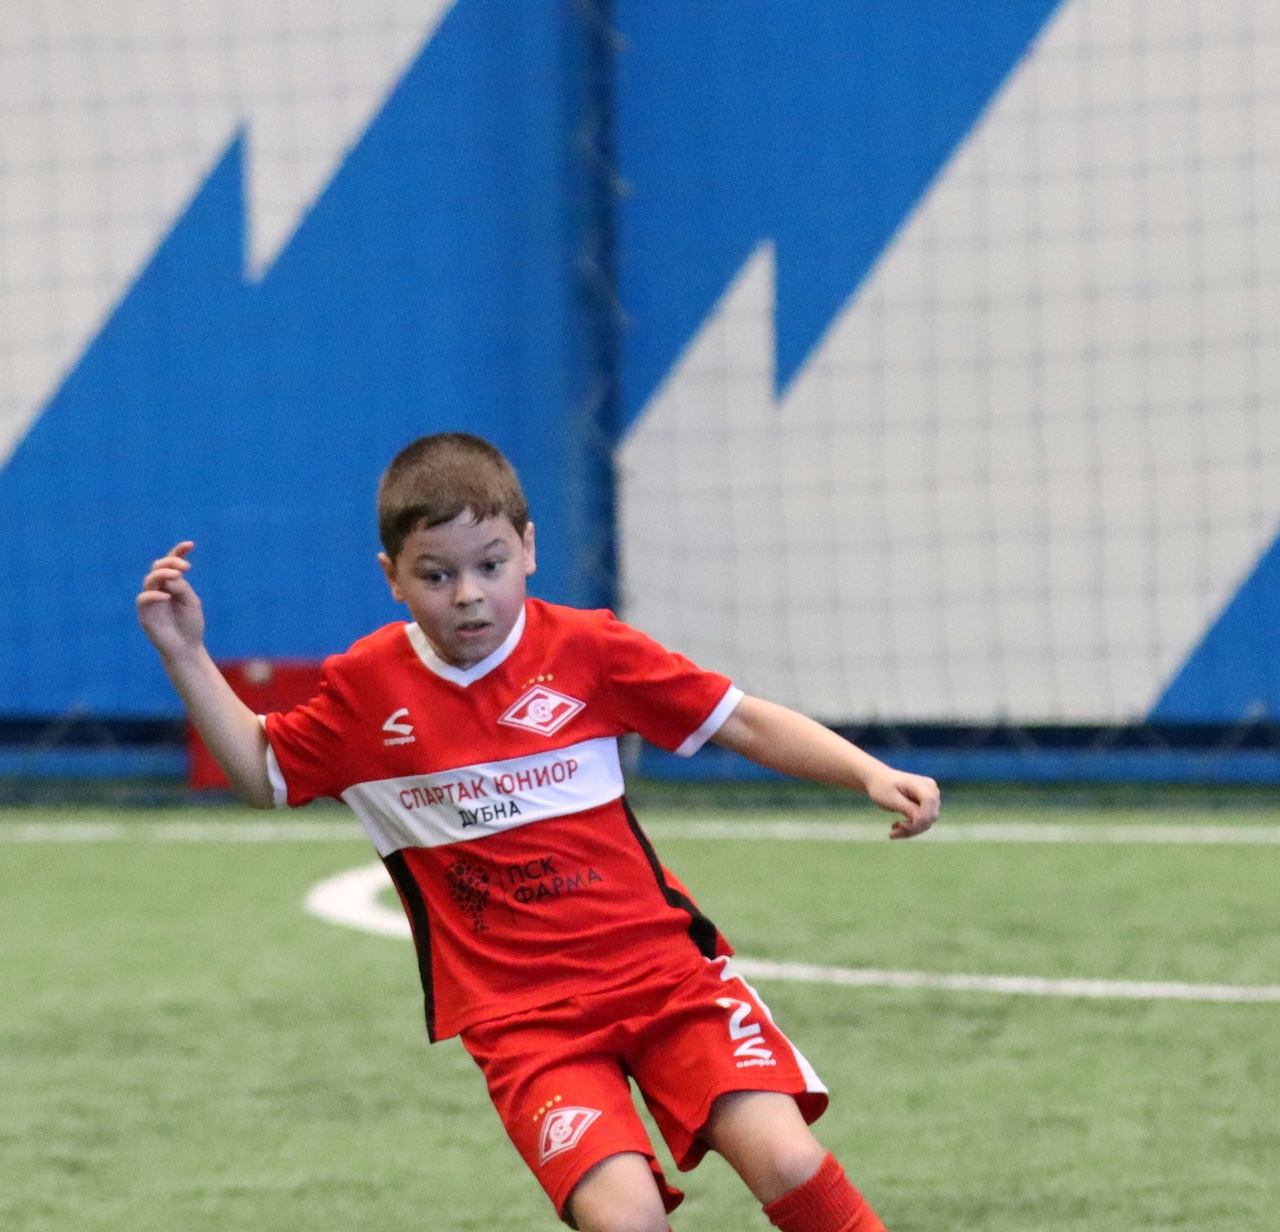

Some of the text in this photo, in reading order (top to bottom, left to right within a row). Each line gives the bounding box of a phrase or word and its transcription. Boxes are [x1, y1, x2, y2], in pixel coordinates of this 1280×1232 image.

[399, 758, 578, 811] СПАРТАК ЮНИОР
[458, 800, 522, 828] ДУБНА
[507, 856, 558, 885] ПСК
[514, 867, 602, 904] ФАРМА
[715, 997, 762, 1041] 2
